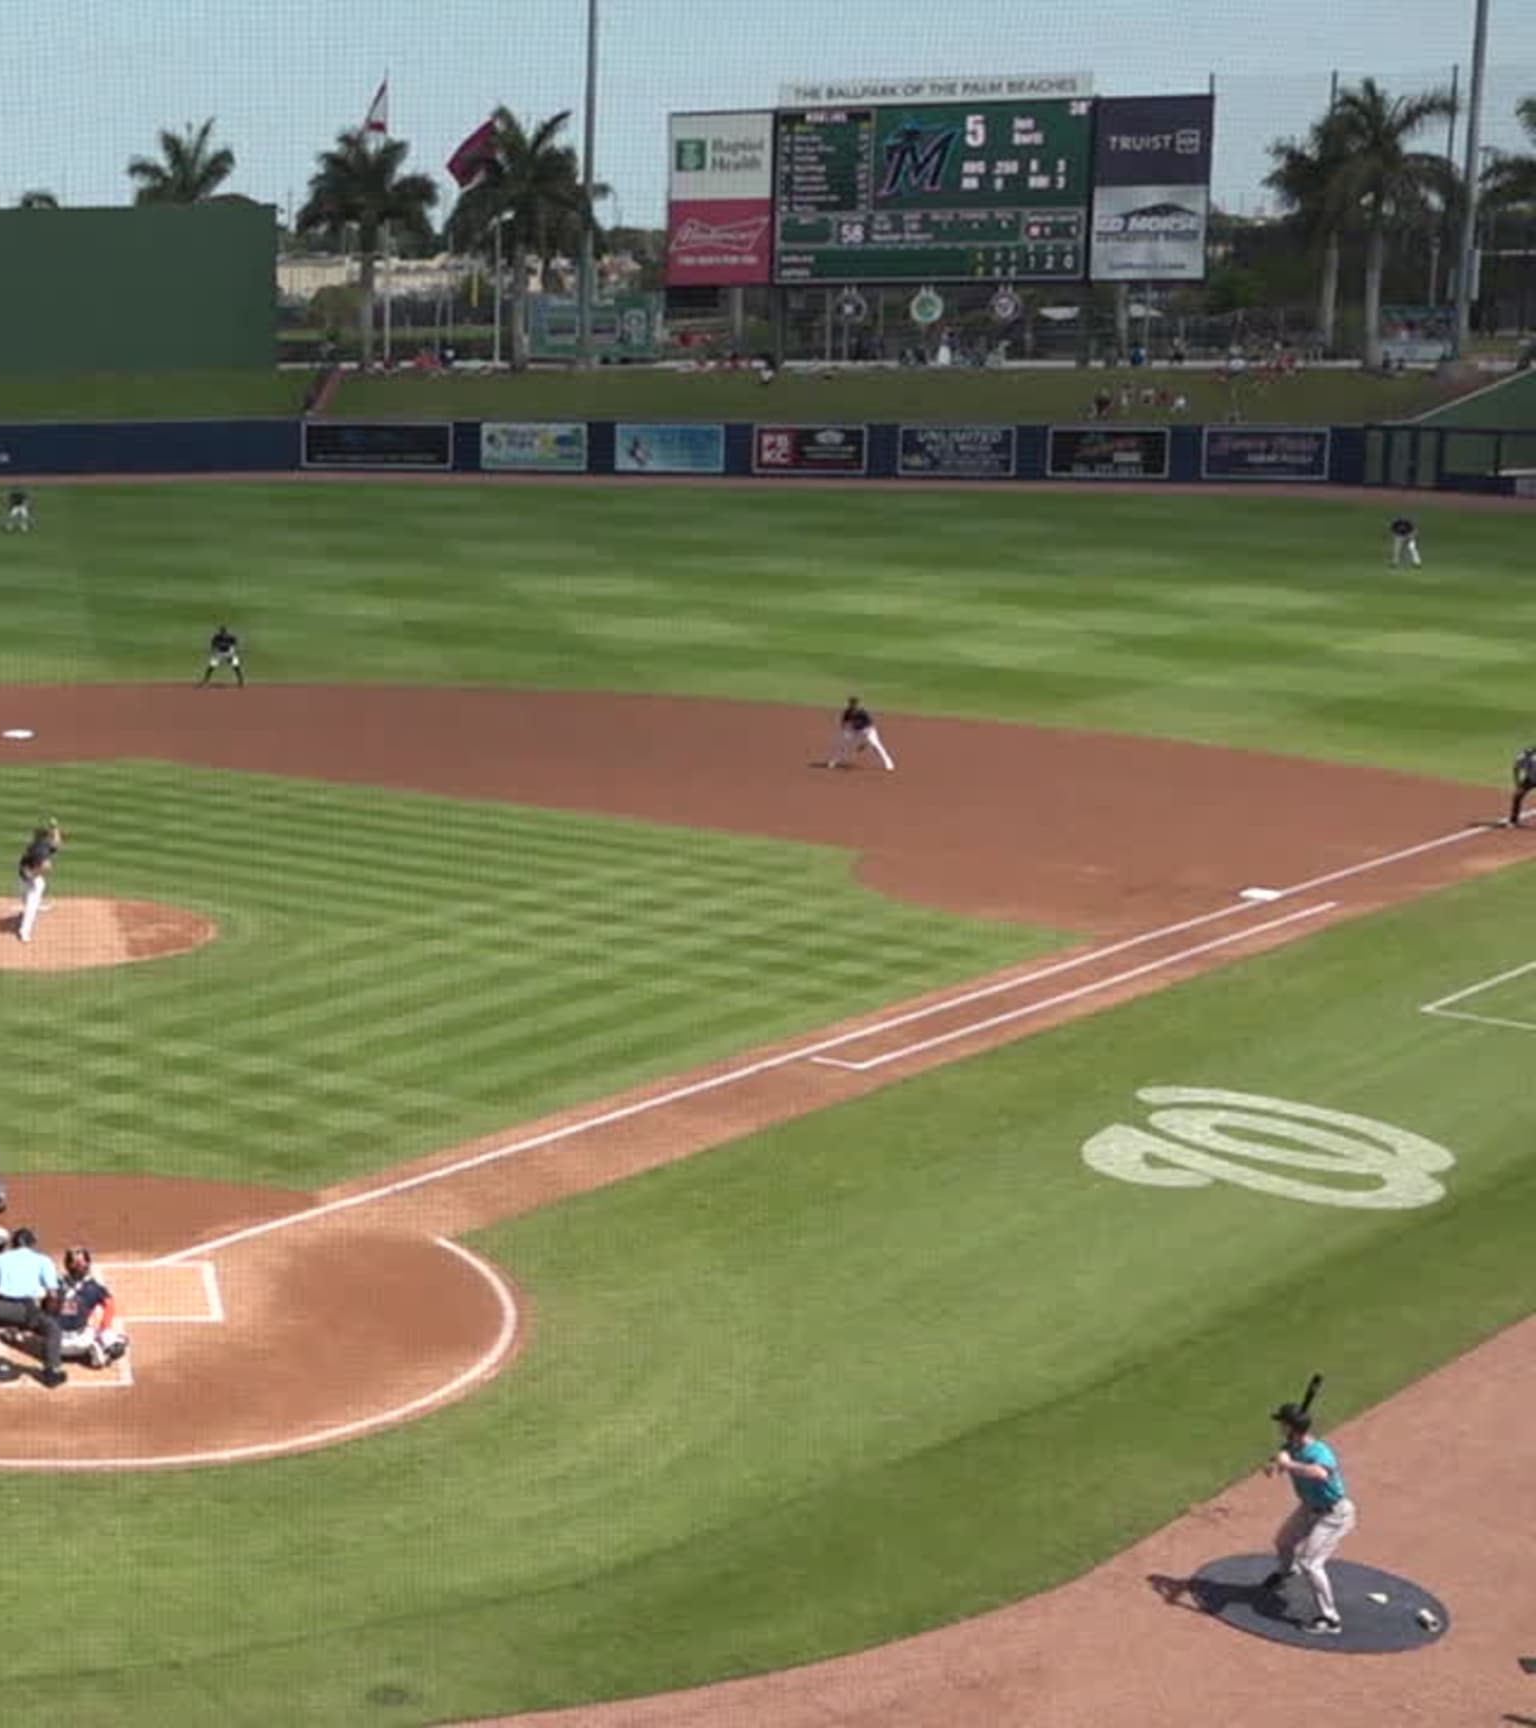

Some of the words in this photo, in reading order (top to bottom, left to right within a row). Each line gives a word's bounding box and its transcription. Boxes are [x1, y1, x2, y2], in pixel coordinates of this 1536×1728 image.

[796, 86, 823, 100] THE
[826, 84, 901, 99] BALLPARK
[903, 83, 924, 97] OF
[930, 82, 959, 96] THE
[963, 80, 1004, 95] PALM
[1008, 79, 1077, 93] BEACHES
[966, 115, 985, 147] 5
[1109, 134, 1173, 151] TRUIST
